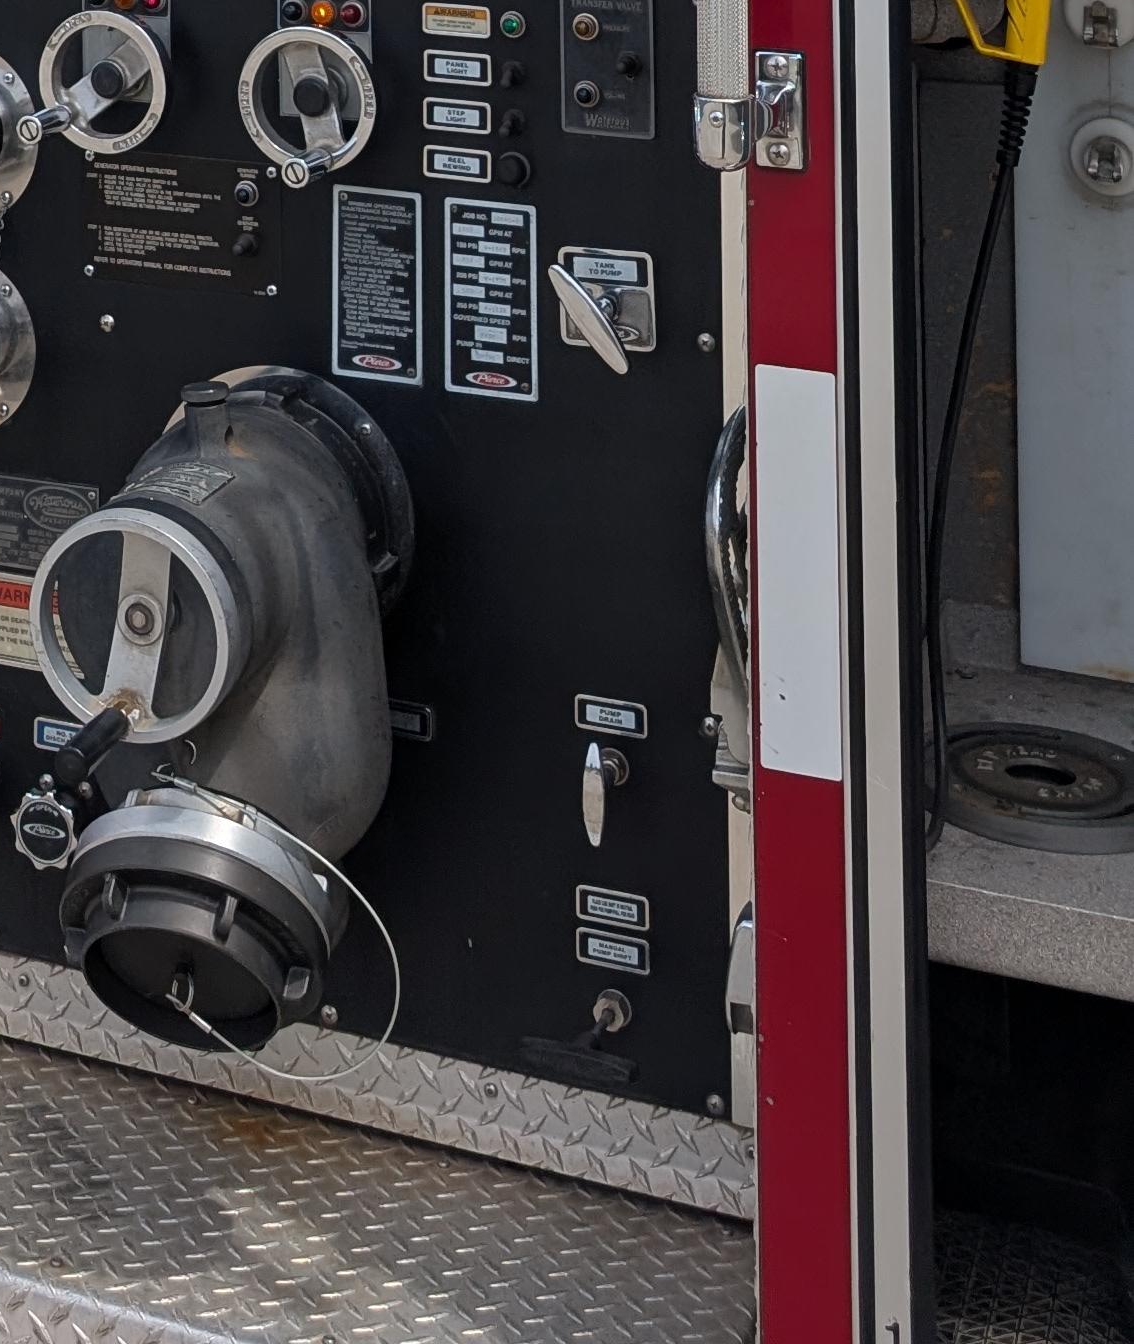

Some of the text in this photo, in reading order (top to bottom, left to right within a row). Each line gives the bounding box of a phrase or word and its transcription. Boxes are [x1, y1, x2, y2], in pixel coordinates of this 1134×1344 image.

[615, 0, 643, 13] VALVE
[445, 61, 469, 69] PANEL
[447, 109, 466, 117] STEP
[445, 115, 467, 123] LIGHT
[447, 157, 467, 165] REEL
[442, 163, 472, 172] REWIND
[174, 264, 198, 273] COMPLETE
[600, 269, 623, 277] PUMP
[453, 313, 511, 326] GOVERNED SPEED
[599, 707, 622, 717] PUMP
[598, 715, 623, 725] DRAIN
[598, 942, 627, 953] MANUAL
[592, 947, 633, 961] PUMP SHIFT
